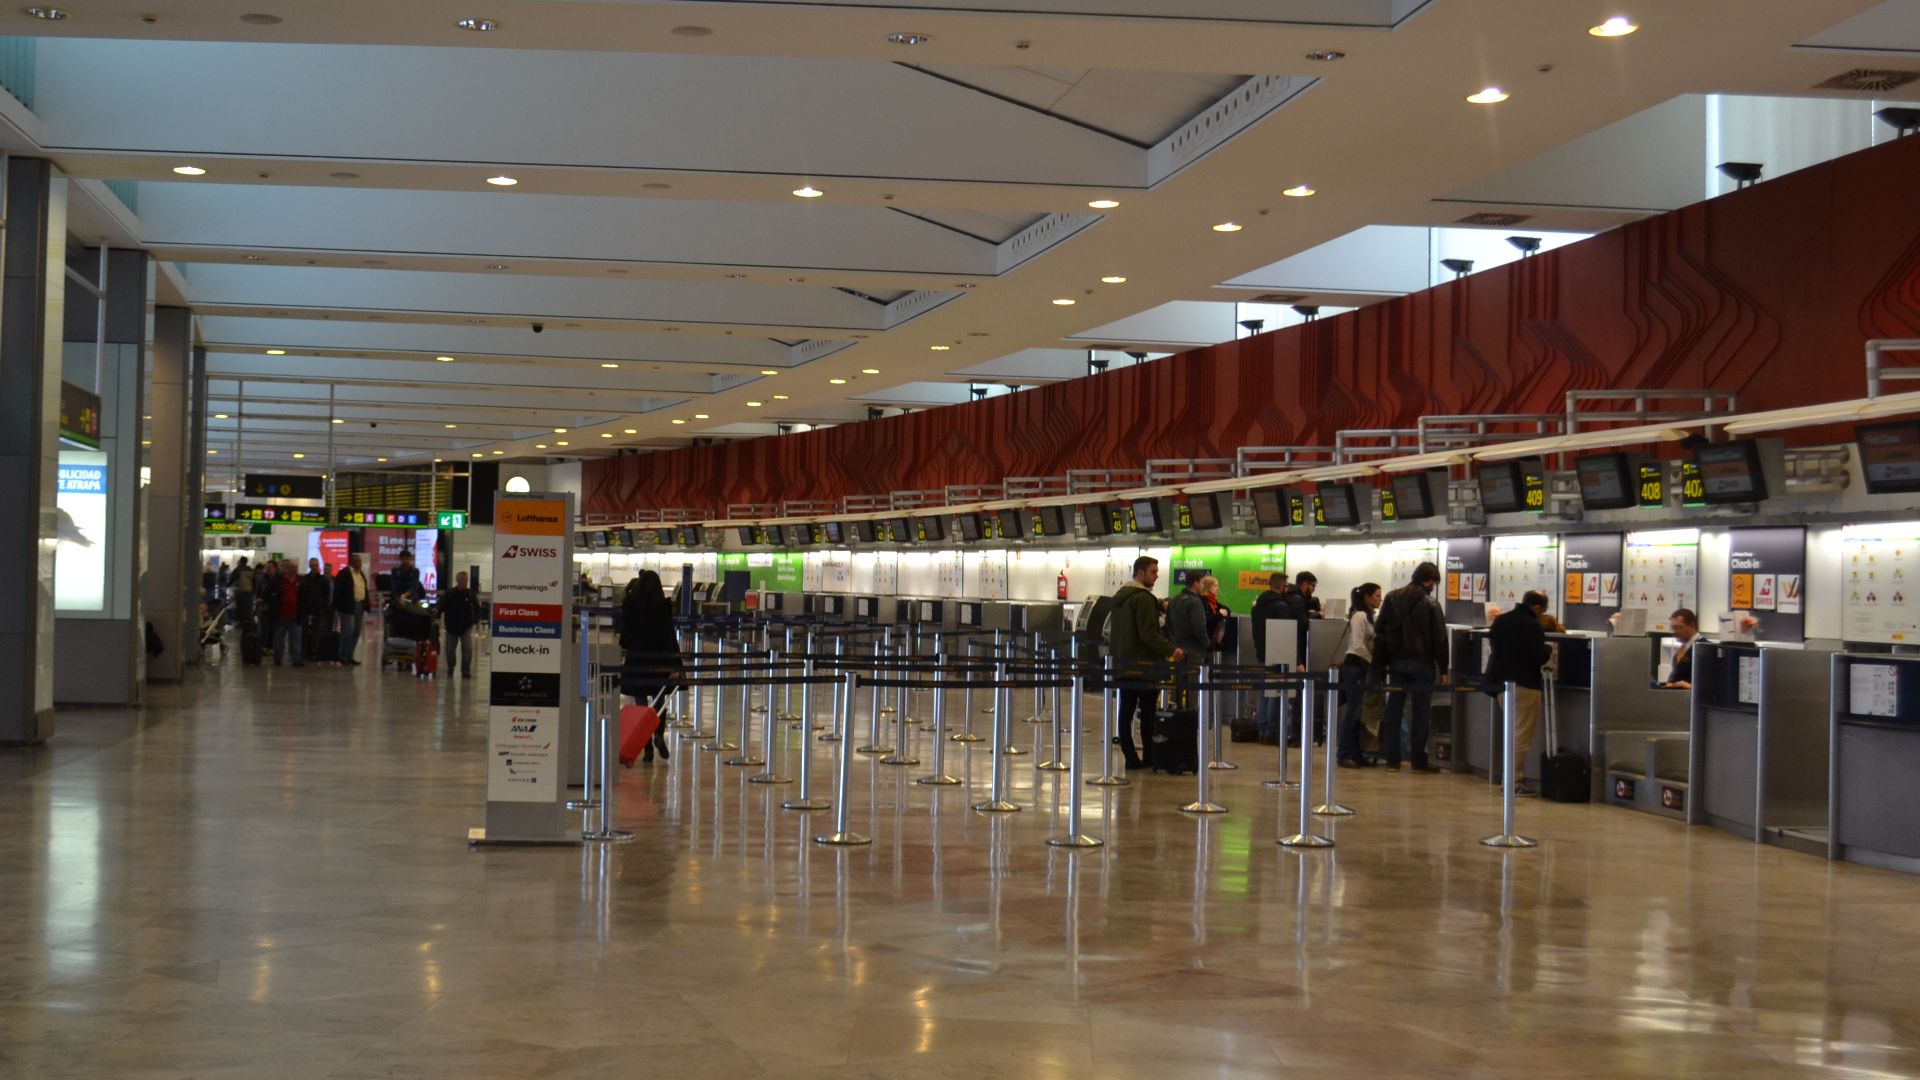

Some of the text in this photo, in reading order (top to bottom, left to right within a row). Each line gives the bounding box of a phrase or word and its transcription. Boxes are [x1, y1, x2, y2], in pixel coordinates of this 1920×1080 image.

[58, 469, 102, 480] BLICIDAD
[67, 480, 101, 491] ATRAPA
[1641, 482, 1661, 500] 408
[1526, 489, 1543, 506] 409
[516, 514, 558, 523] Lufthansa
[519, 547, 557, 558] SWISS
[1566, 560, 1588, 569] Check-in
[1731, 558, 1760, 569] Check-in
[497, 583, 549, 592] germanwings
[499, 608, 539, 617] First Class
[498, 625, 556, 635] Business Class
[498, 644, 550, 655] Check-in
[510, 725, 529, 733] ANA
